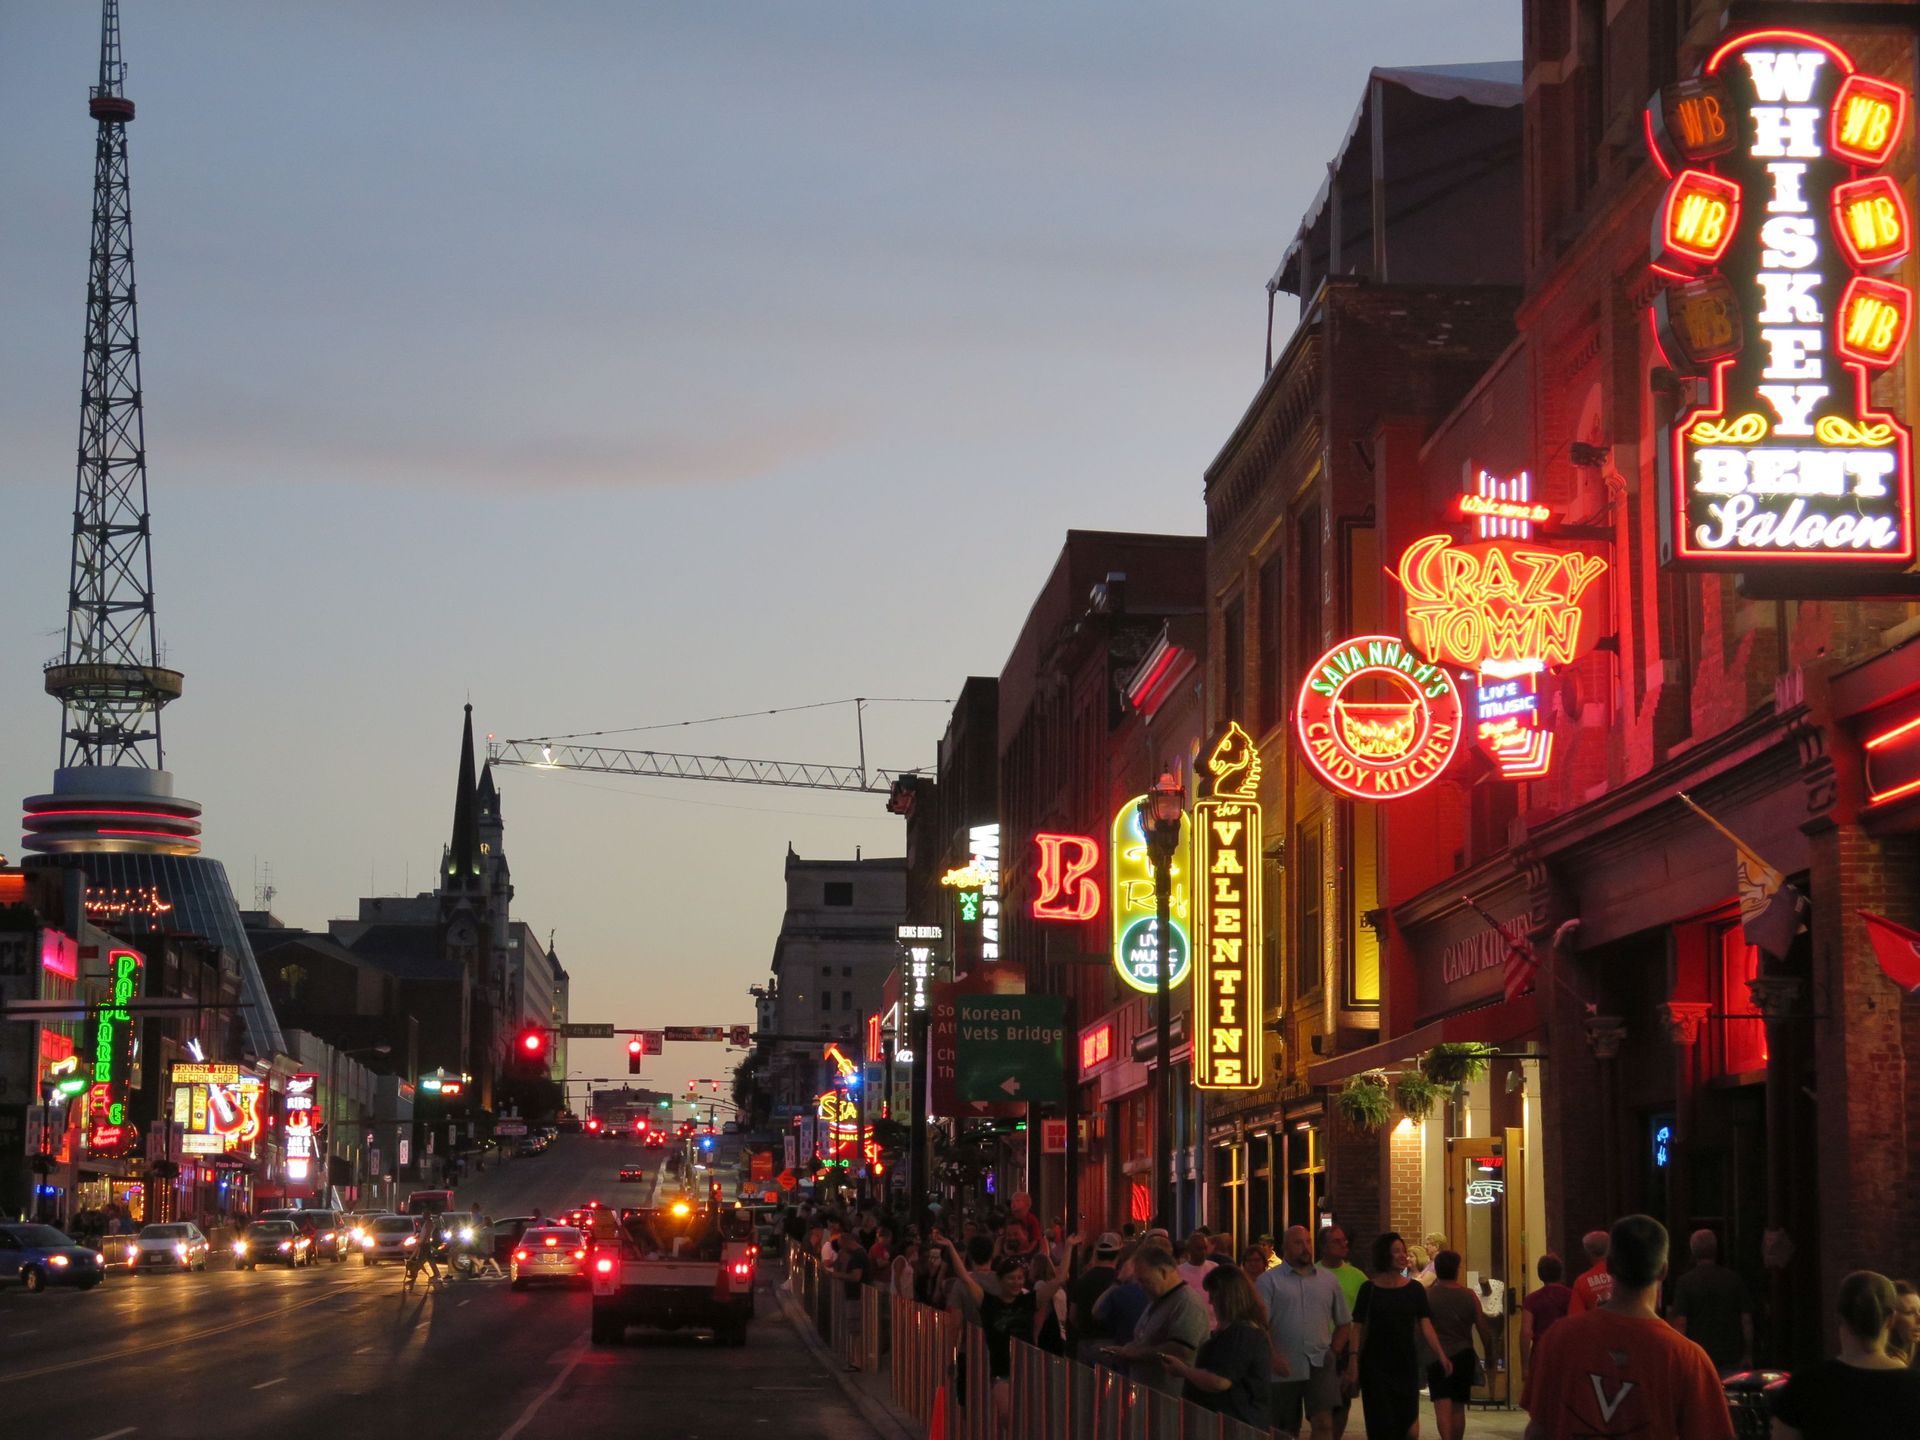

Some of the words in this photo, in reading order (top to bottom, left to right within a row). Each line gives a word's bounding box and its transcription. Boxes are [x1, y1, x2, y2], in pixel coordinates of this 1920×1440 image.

[1677, 96, 1726, 148] WB
[1840, 96, 1889, 150] WB
[1675, 193, 1722, 247] WB
[1743, 51, 1826, 436] WHISKEY
[1848, 197, 1900, 250] WB
[1846, 296, 1896, 350] WB
[1695, 447, 1894, 496] BENT
[1460, 494, 1530, 519] Welcome
[1531, 503, 1550, 521] to
[1697, 490, 1896, 549] Saloon
[1398, 534, 1608, 606] CRAZY
[1406, 605, 1583, 664] TOWN
[1310, 641, 1449, 699] SAVANNAH'S
[1479, 682, 1518, 703] LIVE
[1479, 695, 1535, 719] MUSIC
[1306, 721, 1369, 789] CANDY
[1374, 721, 1454, 792] KITCHEN
[1213, 802, 1241, 818] the
[911, 947, 929, 1010] WHIS
[1212, 821, 1243, 1084] VALENTINE
[1443, 934, 1480, 984] CANDY
[962, 1007, 1021, 1021] Korean
[963, 1026, 999, 1041] Vets
[1007, 1026, 1062, 1042] Bridge
[95, 1004, 113, 1082] PARK
[173, 1064, 210, 1073] ERNEST
[214, 1064, 239, 1073] TUBB
[177, 1074, 210, 1083] RECORD
[212, 1074, 234, 1083] SHOP
[287, 1097, 312, 1109] RIBS
[1587, 1373, 1636, 1425] V
